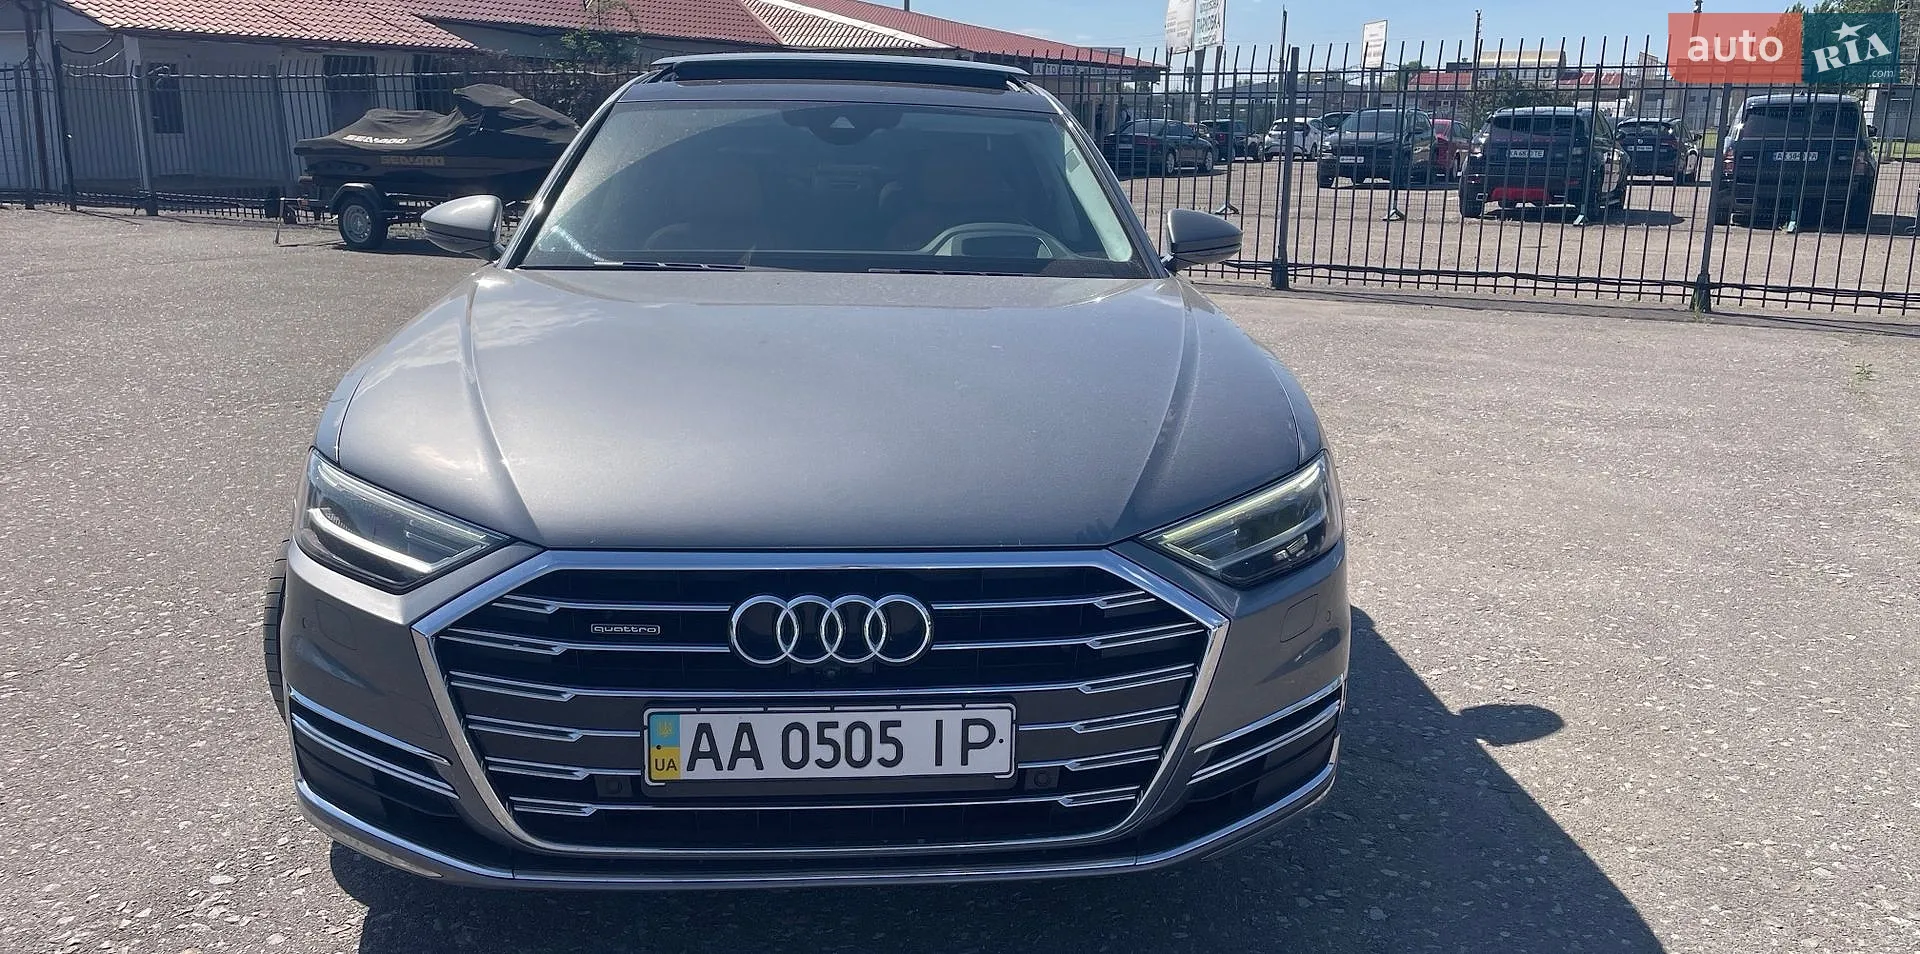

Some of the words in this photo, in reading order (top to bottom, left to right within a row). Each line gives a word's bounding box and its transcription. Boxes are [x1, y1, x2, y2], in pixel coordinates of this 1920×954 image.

[687, 722, 764, 772] AA
[781, 720, 904, 770] 0505
[934, 718, 997, 767] IP
[654, 758, 678, 772] UA
